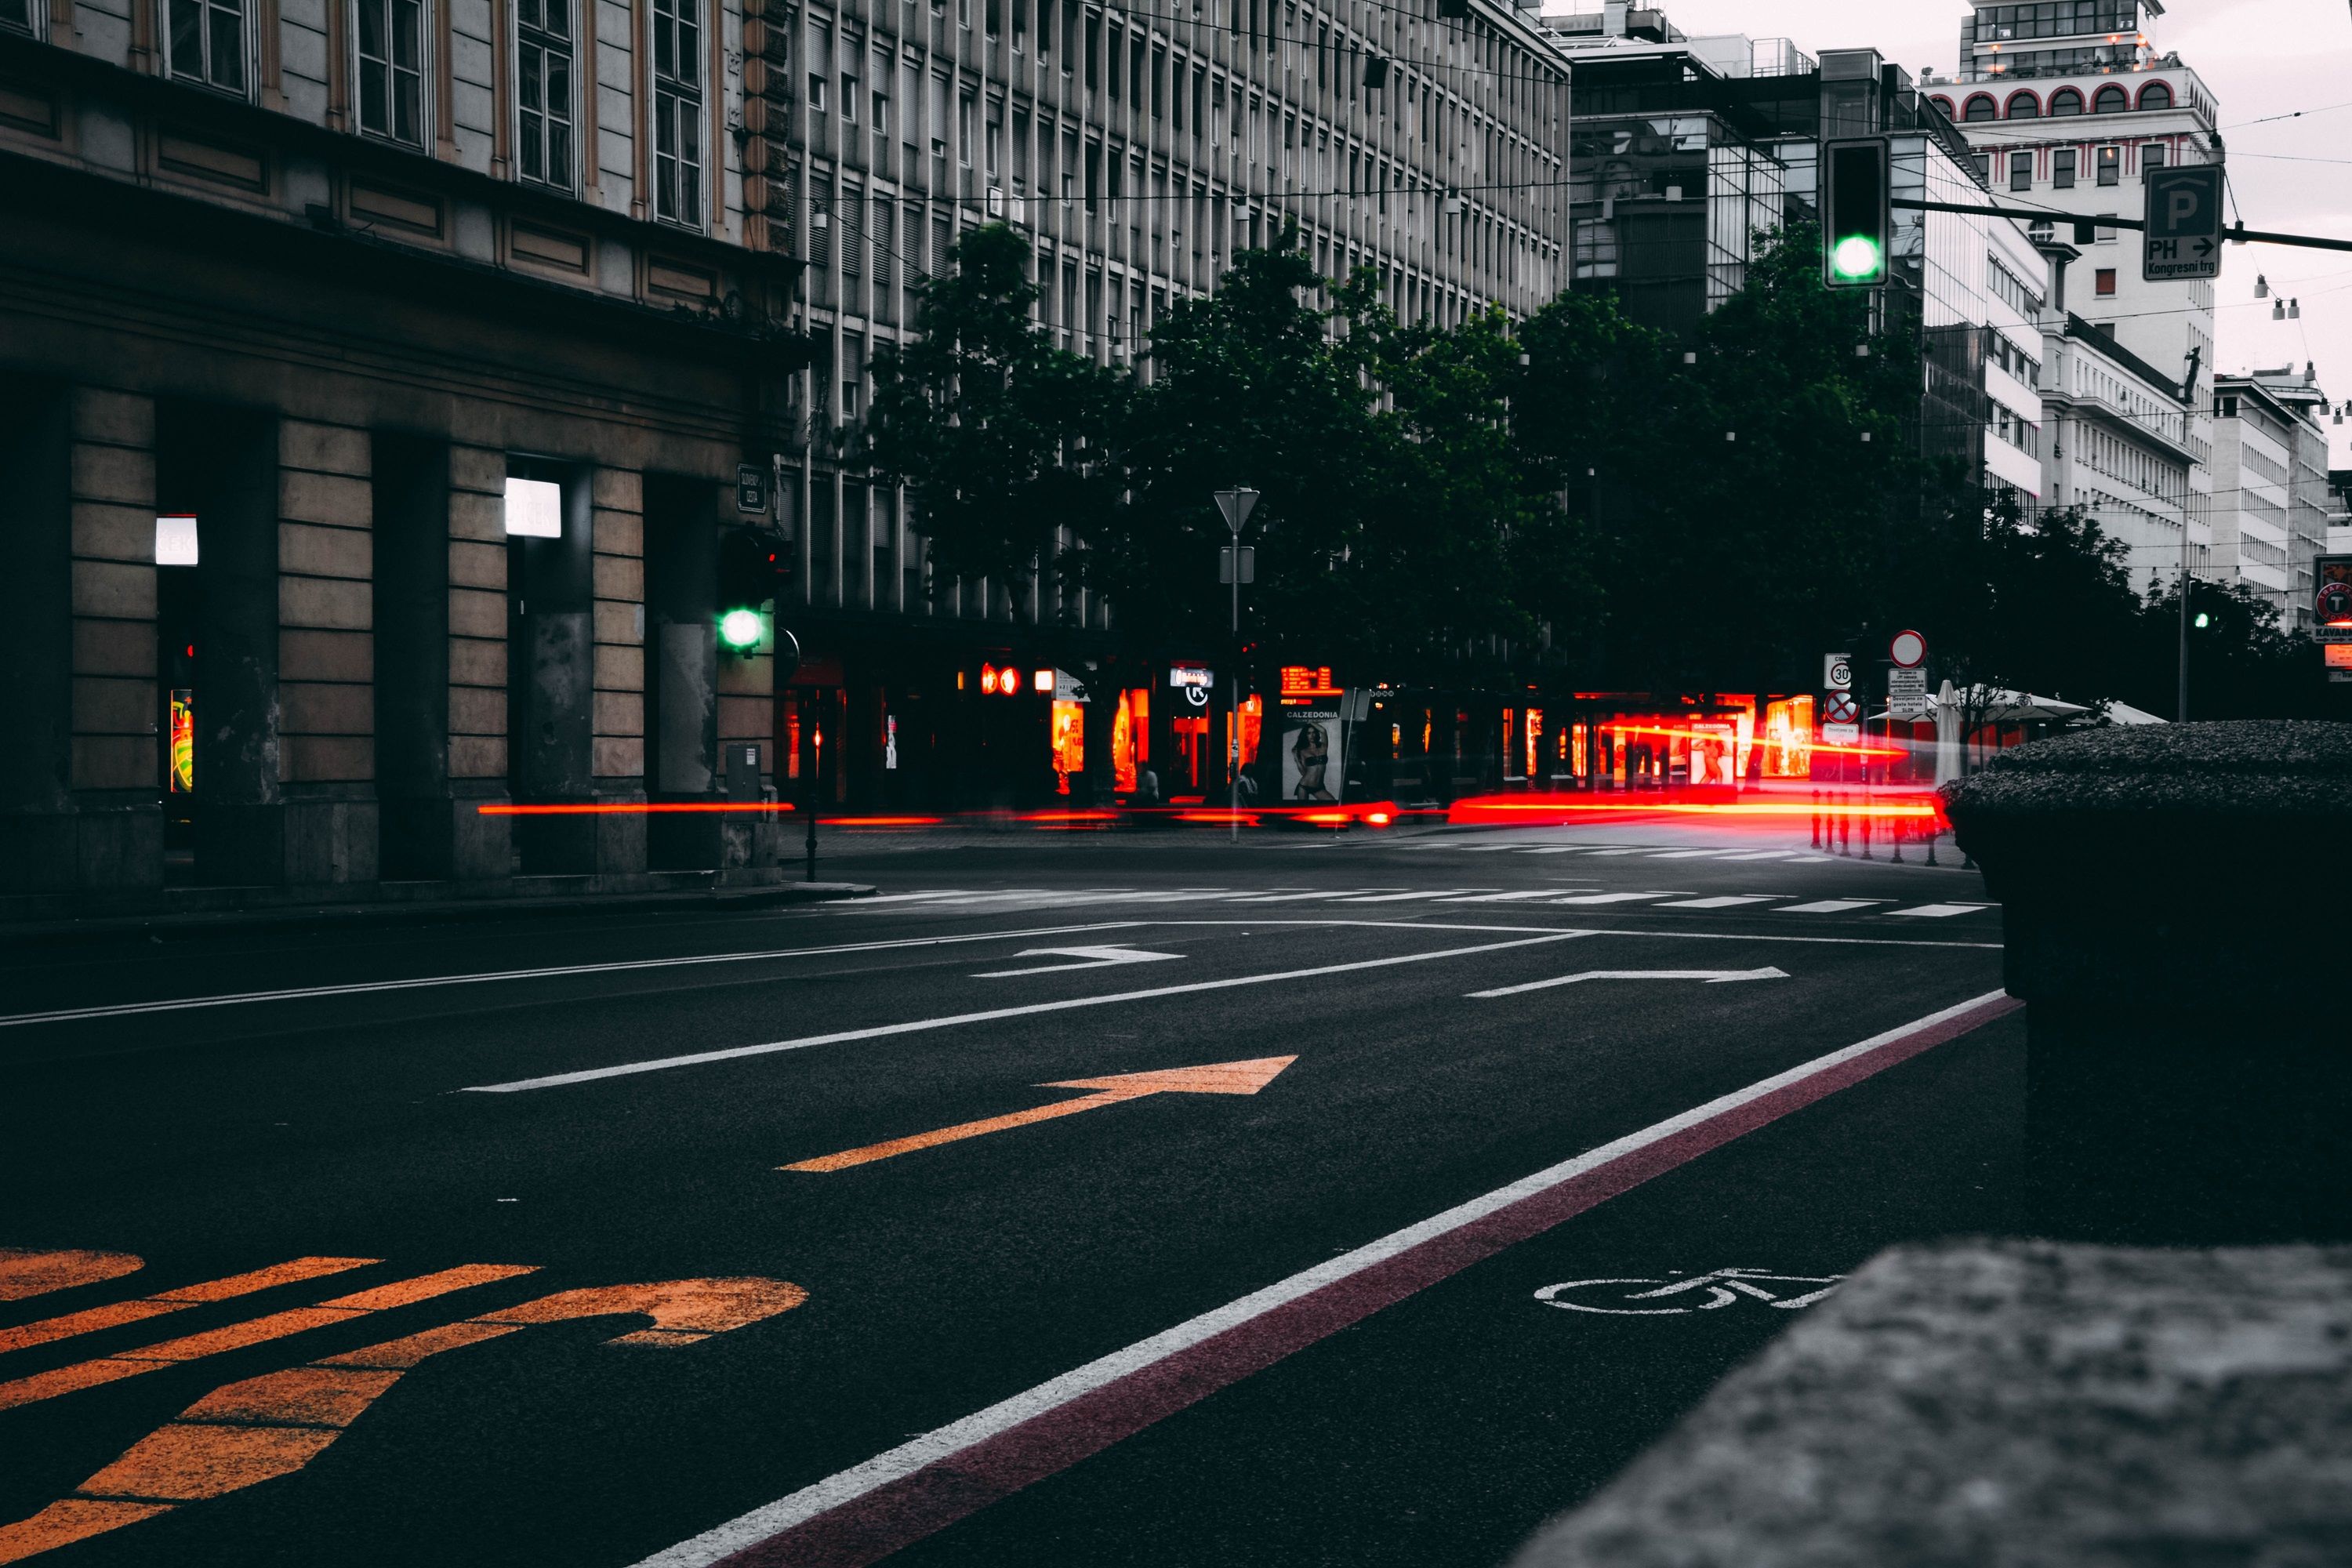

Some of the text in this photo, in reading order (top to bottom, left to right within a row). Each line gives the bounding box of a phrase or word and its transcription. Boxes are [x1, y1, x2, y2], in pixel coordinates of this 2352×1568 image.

[2169, 191, 2198, 230] P
[2149, 239, 2177, 260] PH
[2148, 261, 2215, 276] Kongresni trg
[741, 473, 762, 487] SLOVENSA
[2330, 596, 2344, 612] T
[1835, 669, 1849, 680] 30
